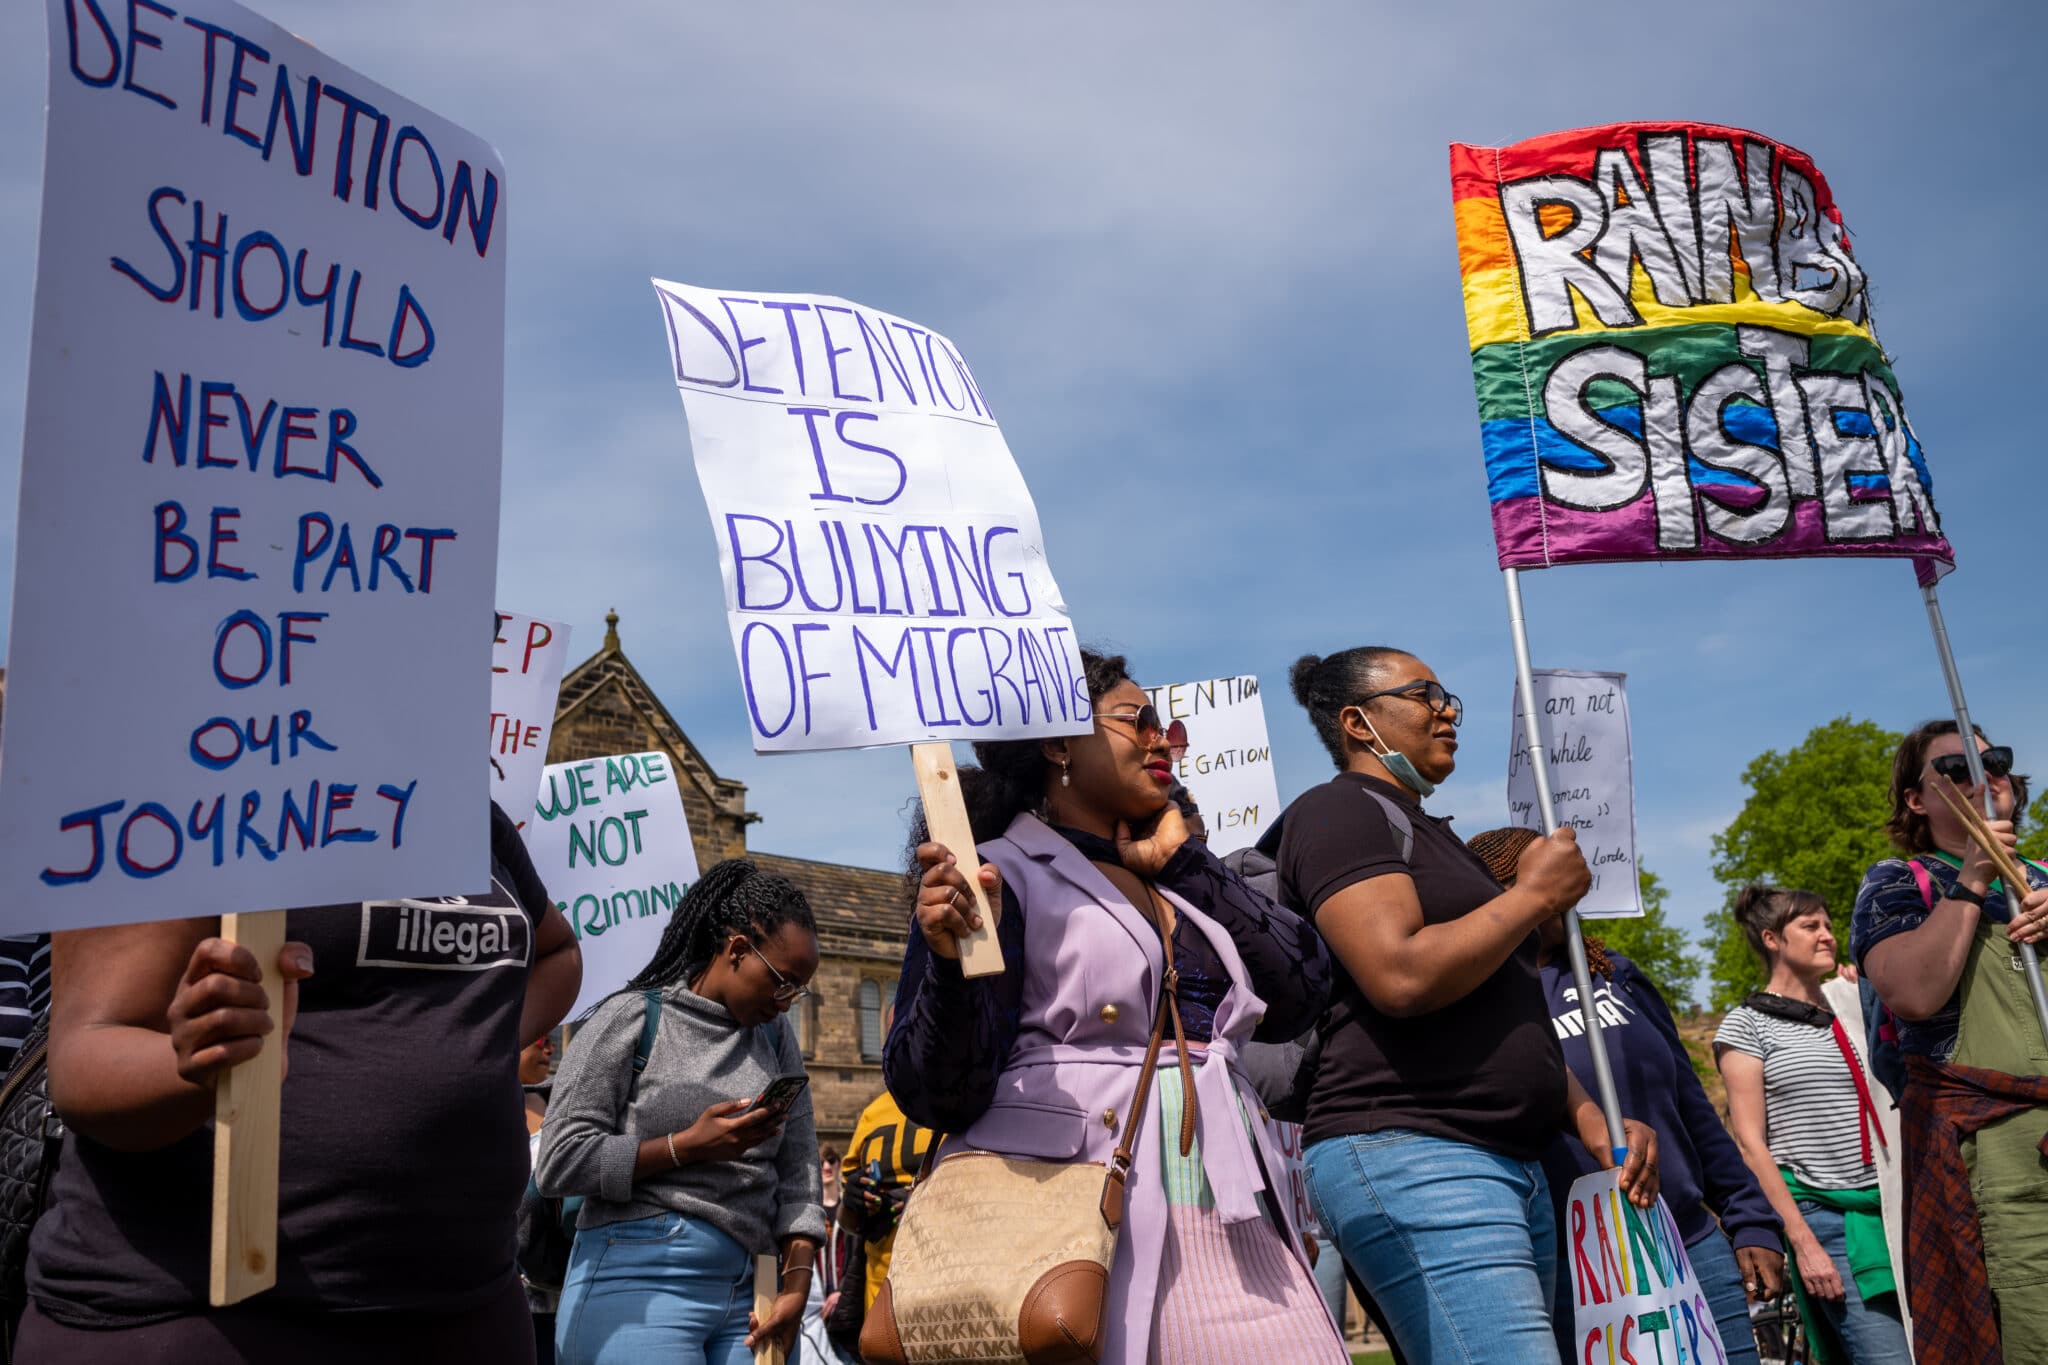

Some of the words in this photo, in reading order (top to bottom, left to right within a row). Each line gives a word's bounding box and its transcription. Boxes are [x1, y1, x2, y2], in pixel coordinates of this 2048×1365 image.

[64, 0, 498, 257] DETENTION
[110, 186, 435, 367] SHOULD
[143, 370, 383, 488] NEVER
[787, 407, 907, 505] IS
[1540, 323, 1942, 551] SISTER
[154, 500, 258, 583] BE
[293, 511, 457, 594] PART
[725, 513, 1032, 617] BULLYING
[213, 609, 329, 689] OF
[741, 621, 831, 738] OF
[852, 624, 1093, 731] MIGRANTS
[1143, 676, 1259, 719] TENTION
[1545, 697, 1576, 716] am
[1586, 687, 1616, 714] not
[189, 709, 338, 770] OUR
[1179, 746, 1269, 778] EGATION
[1550, 732, 1593, 766] while
[535, 764, 602, 821] WE
[606, 754, 667, 795] ARE
[1512, 801, 1533, 825] any
[1552, 788, 1591, 805] oman
[39, 779, 417, 886] JOURNEY
[568, 809, 649, 869] NOT
[397, 907, 510, 964] illegal
